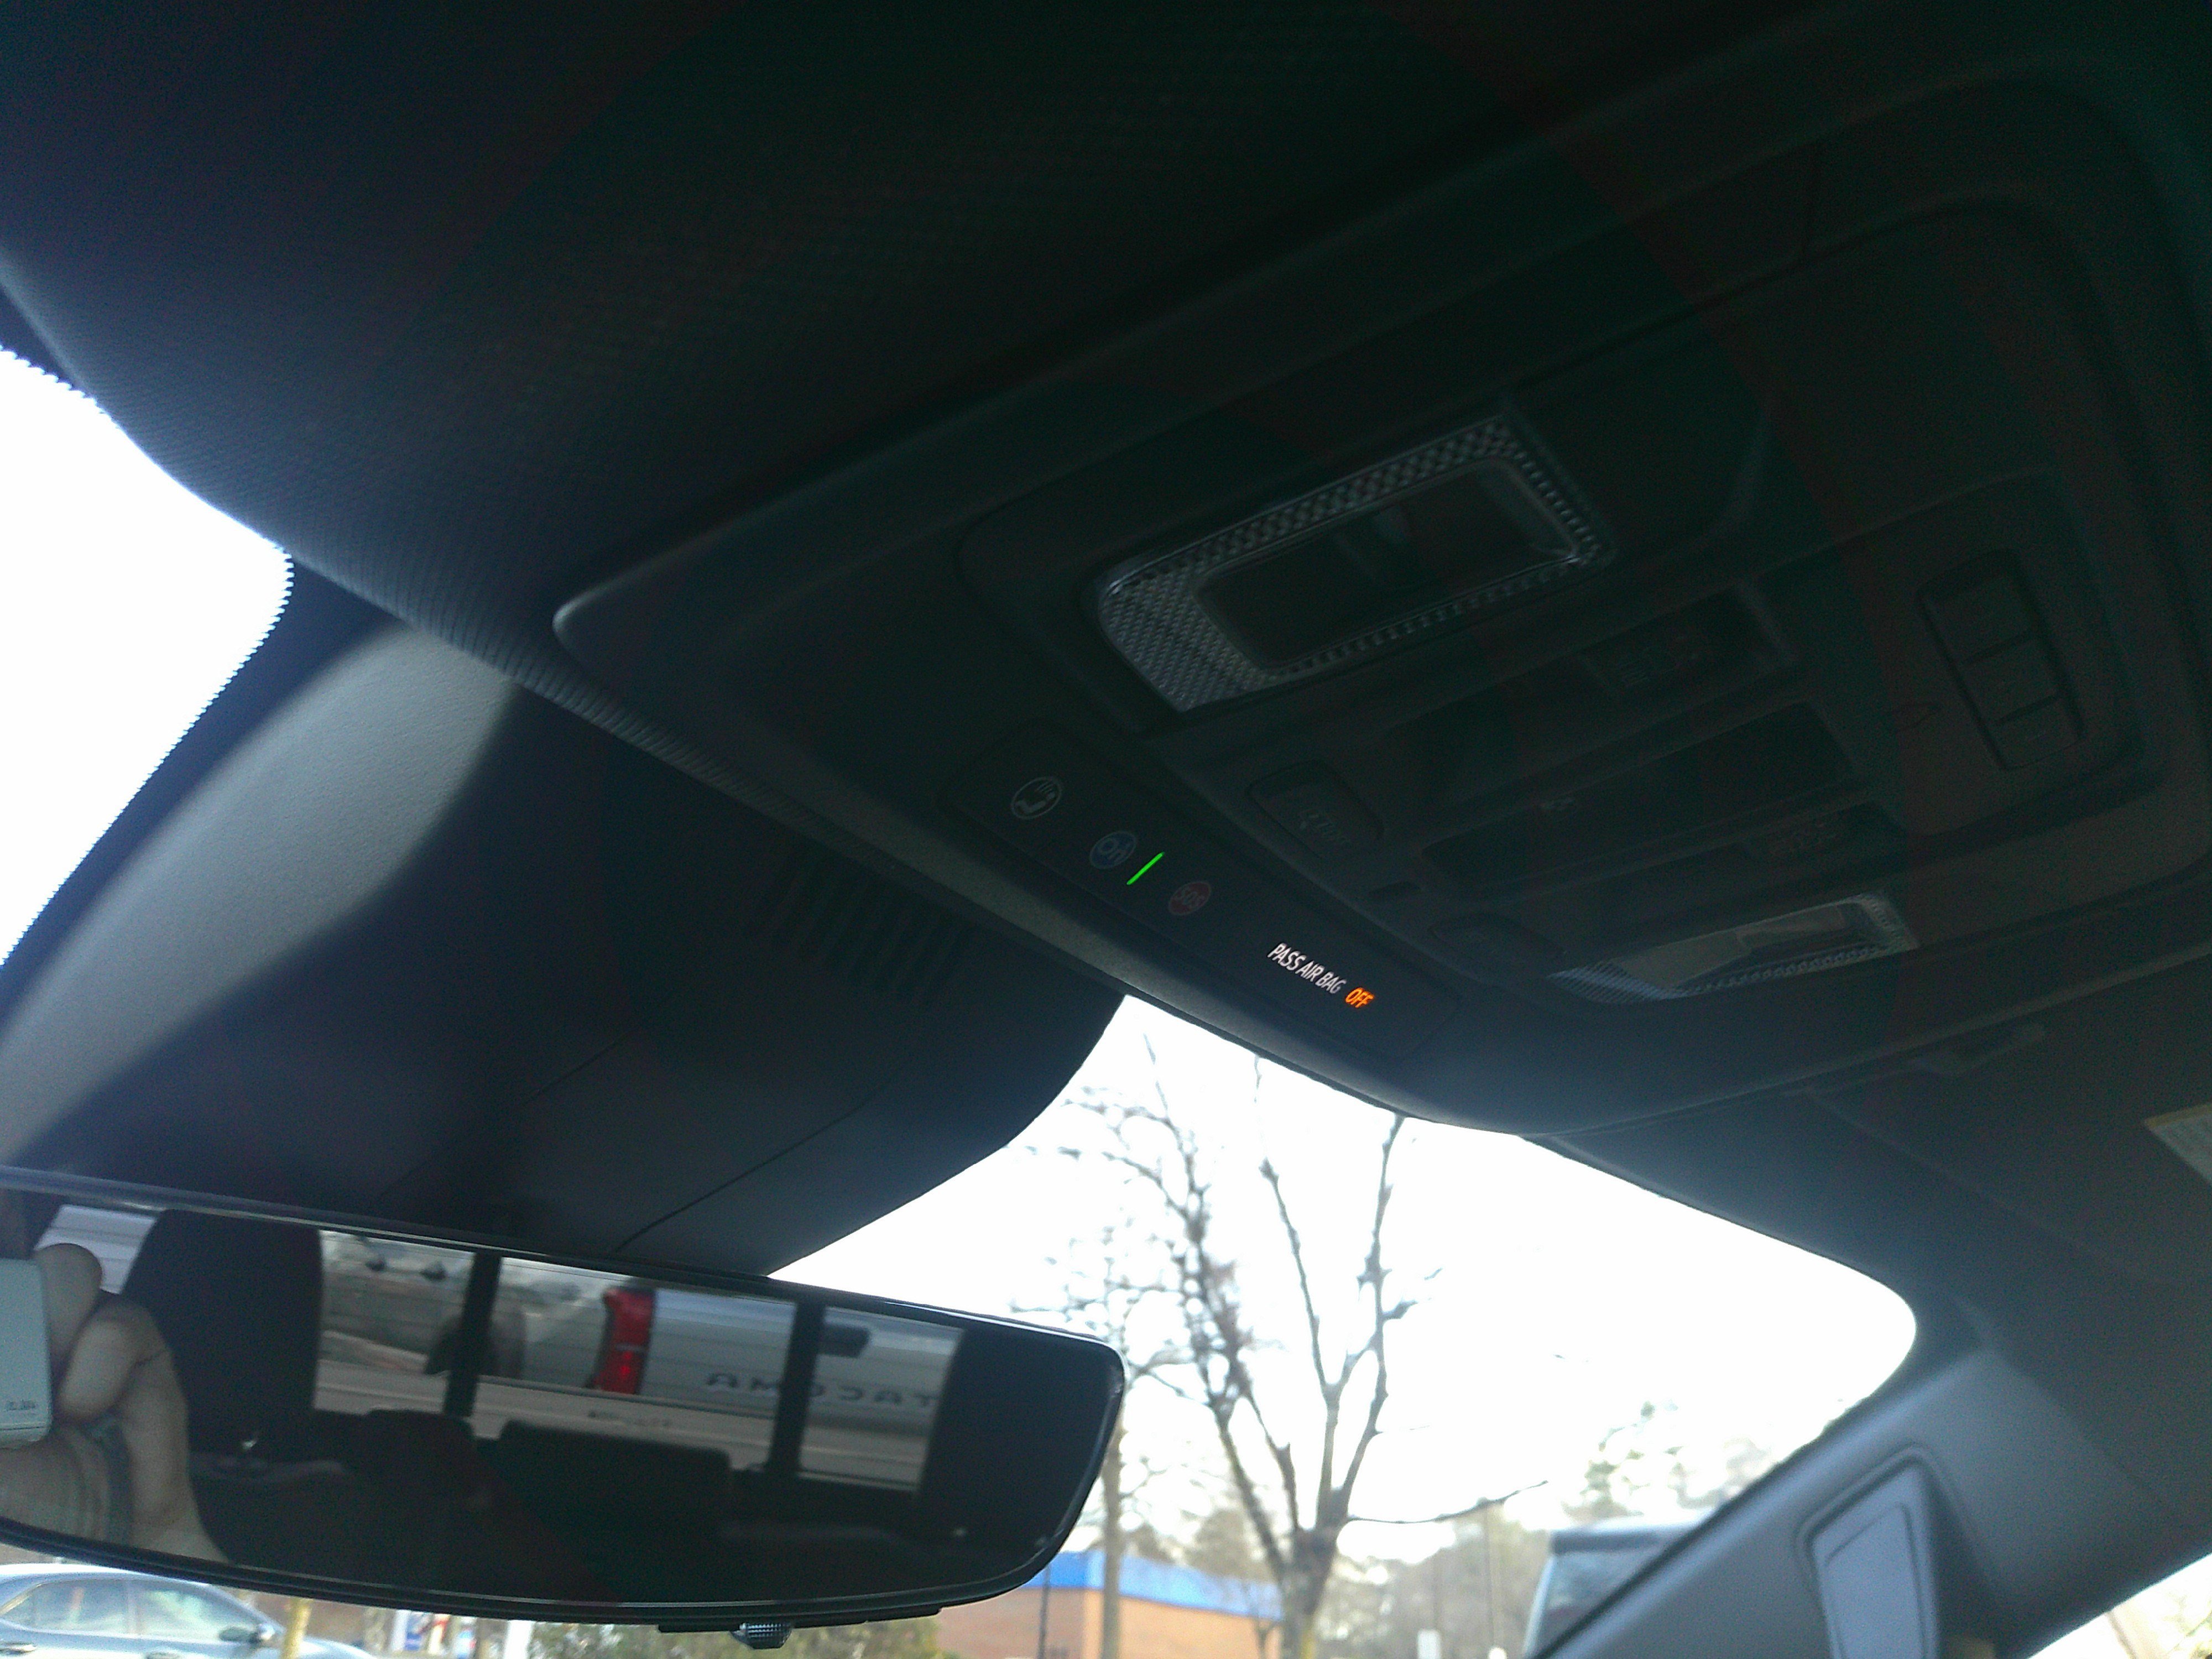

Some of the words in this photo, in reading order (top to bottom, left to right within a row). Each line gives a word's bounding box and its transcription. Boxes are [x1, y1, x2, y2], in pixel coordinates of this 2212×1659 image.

[1267, 942, 1307, 971] PASS
[1295, 960, 1325, 982] AIR
[1315, 972, 1347, 994] BAG
[1345, 987, 1375, 1009] OFF
